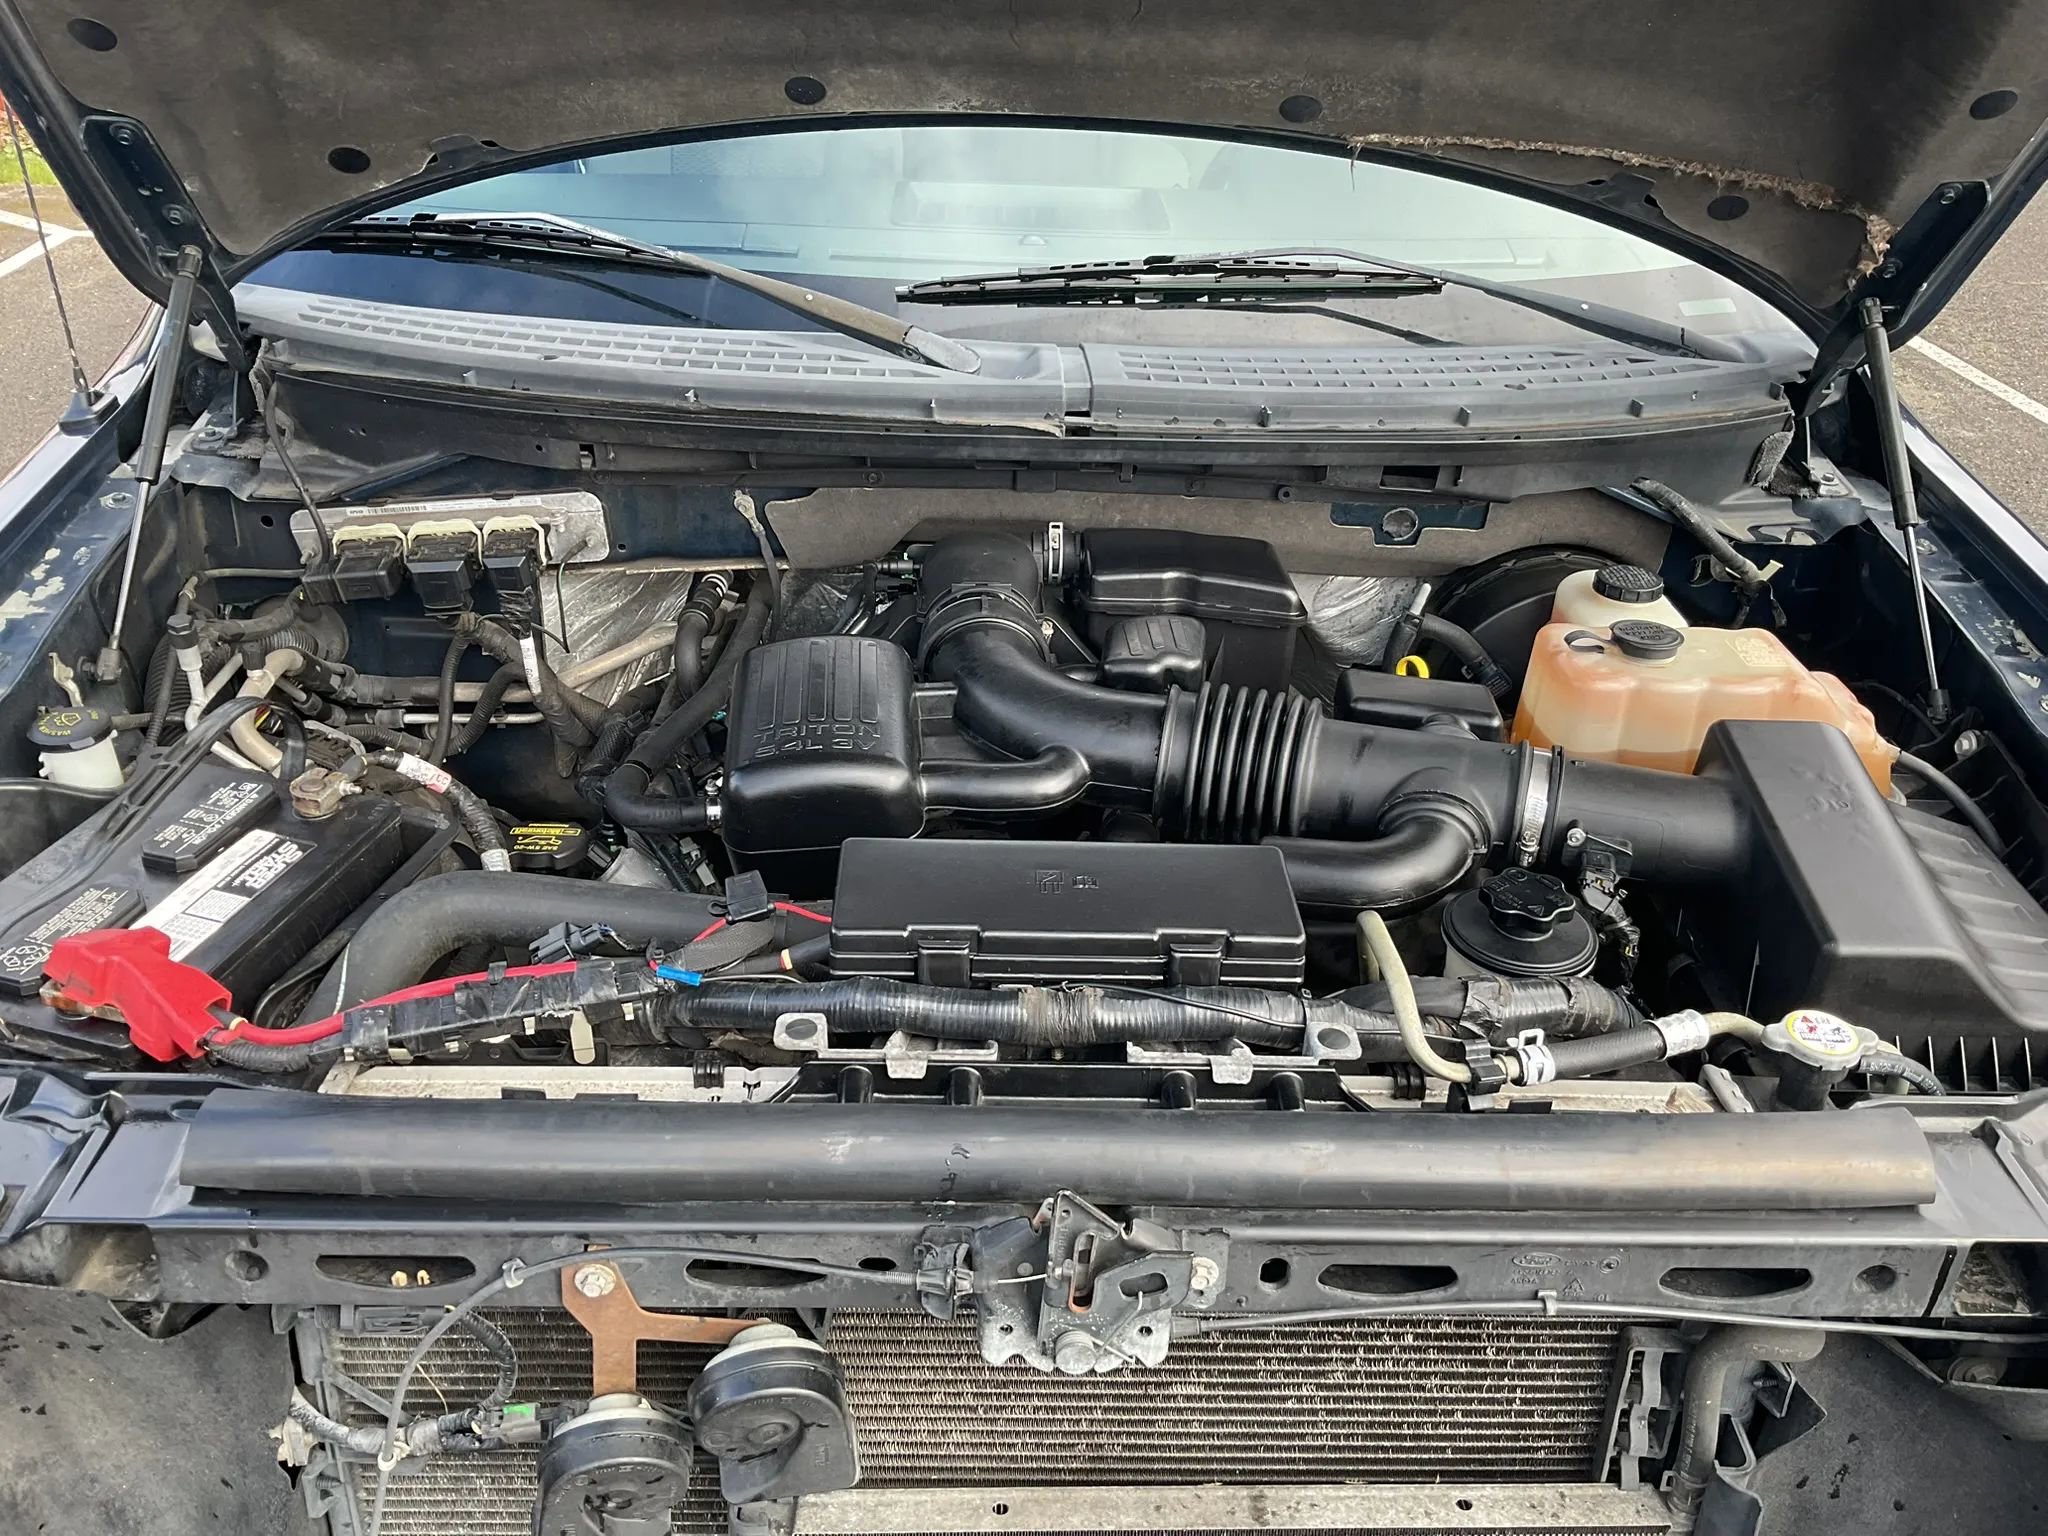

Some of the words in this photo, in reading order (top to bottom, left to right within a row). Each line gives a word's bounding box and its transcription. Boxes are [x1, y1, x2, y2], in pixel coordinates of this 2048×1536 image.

[753, 723, 881, 744] TRITON
[754, 739, 823, 758] 5.4L
[831, 738, 877, 750] 3V
[244, 840, 299, 888] START
[250, 849, 304, 890] SUPER
